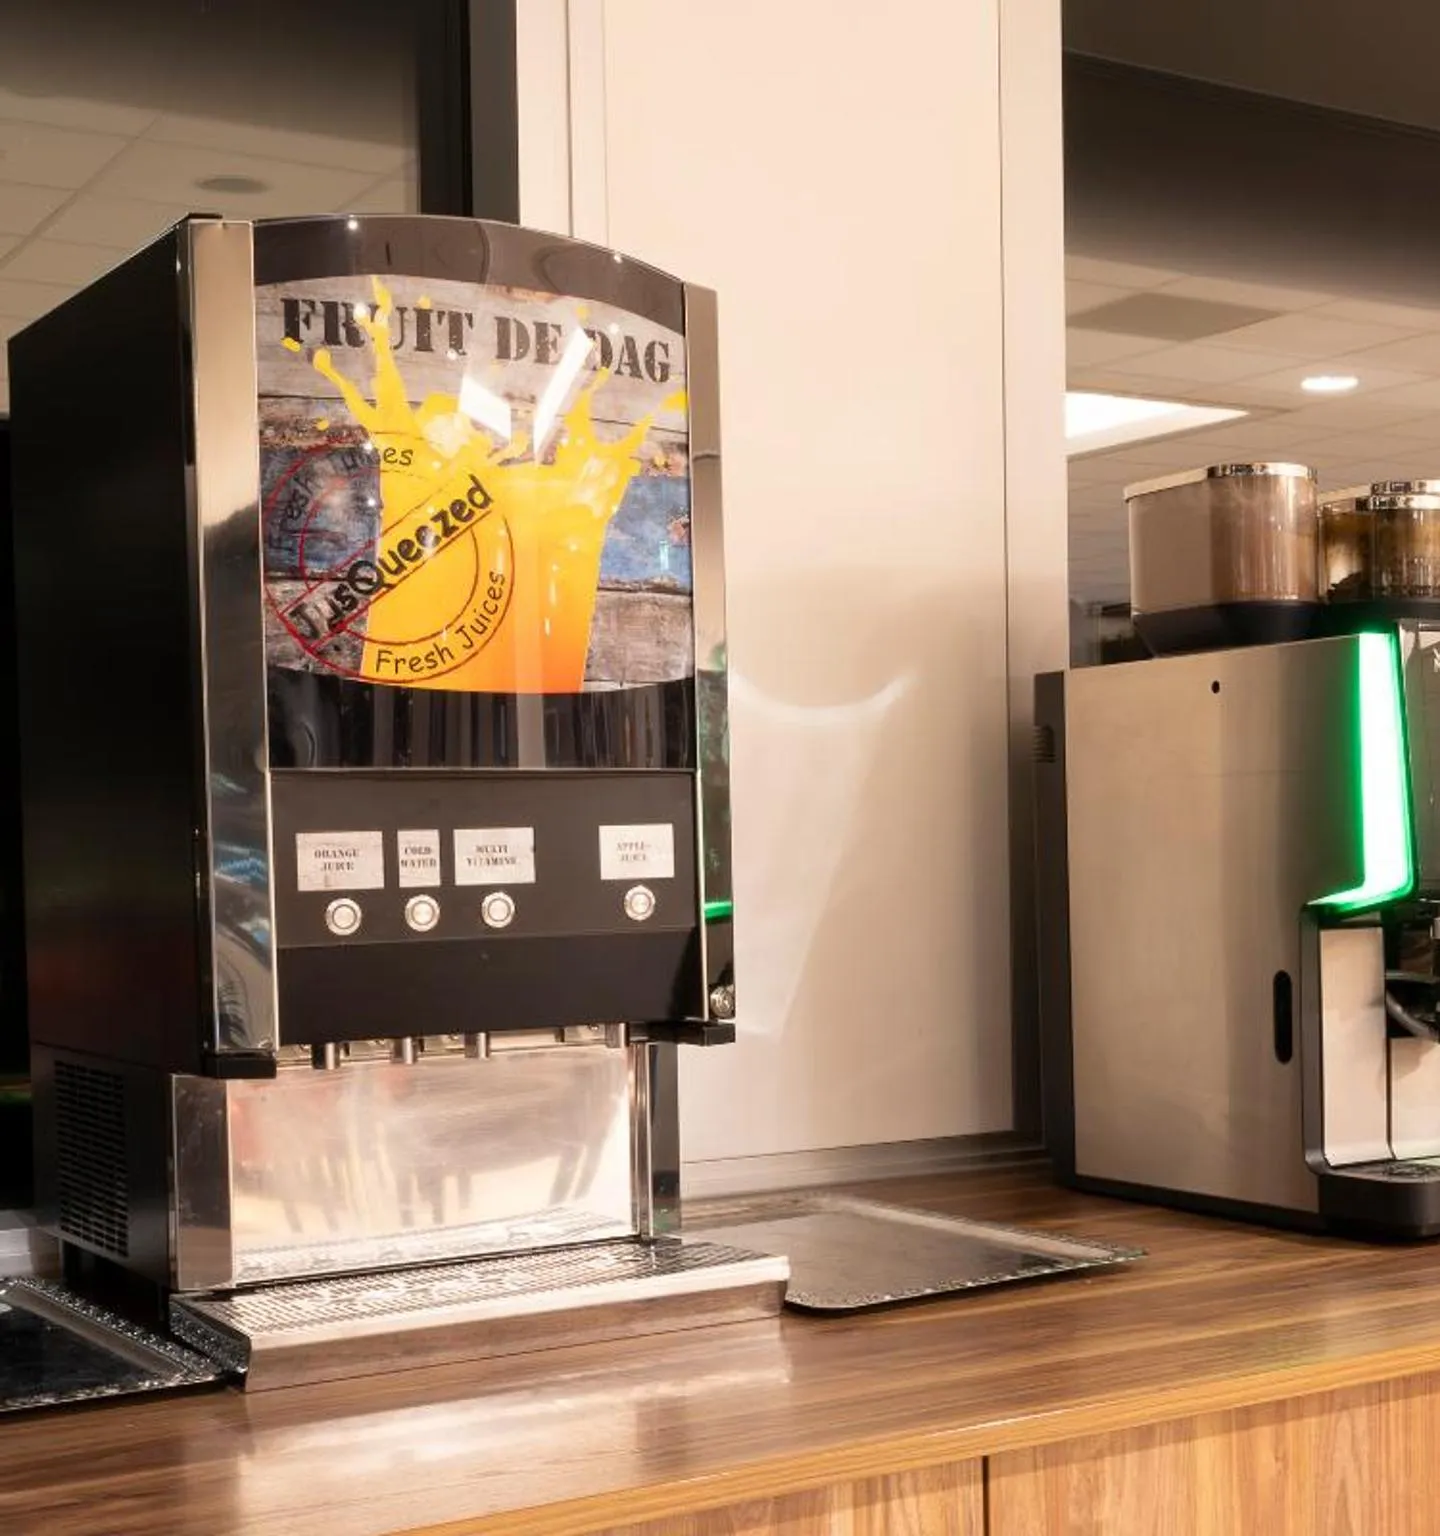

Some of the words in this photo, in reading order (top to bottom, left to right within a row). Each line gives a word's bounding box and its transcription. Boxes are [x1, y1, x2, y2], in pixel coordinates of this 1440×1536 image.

[280, 297, 474, 356] FRUIT
[494, 314, 563, 365] DE
[583, 326, 670, 384] DAG
[375, 642, 455, 675] Fresh
[454, 570, 506, 650] Juices
[313, 847, 360, 859] ORANGE
[320, 861, 355, 872] JUICE
[400, 857, 437, 869] WATER
